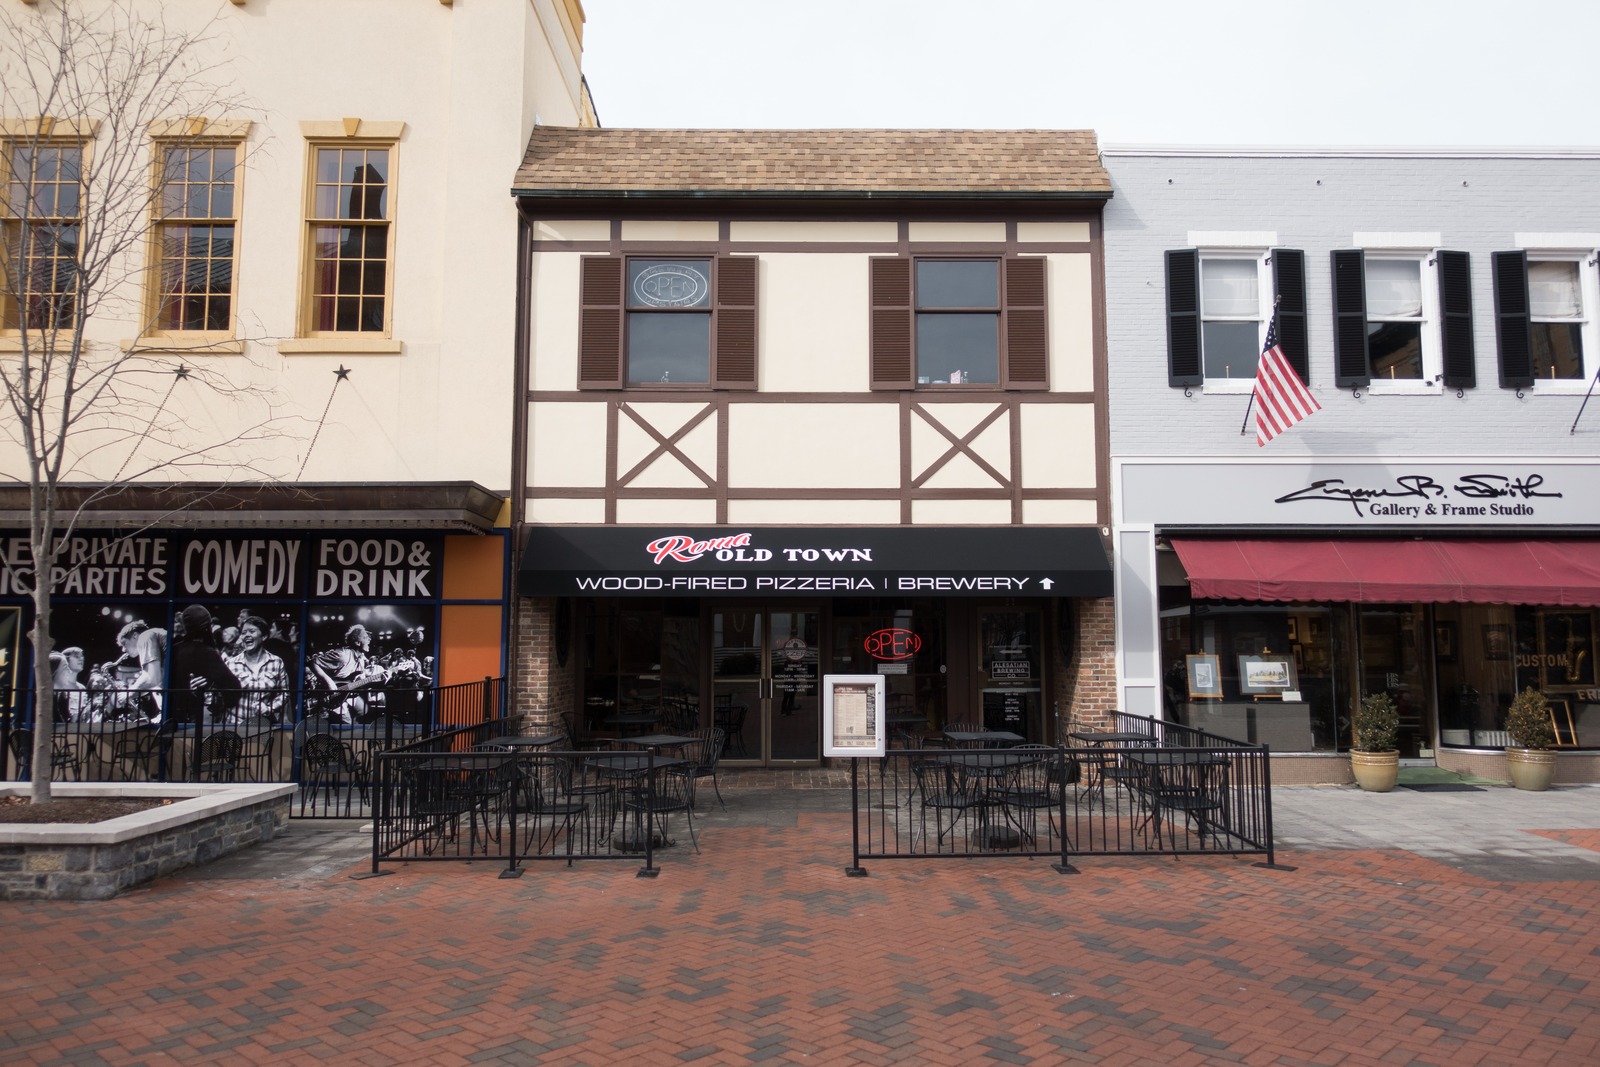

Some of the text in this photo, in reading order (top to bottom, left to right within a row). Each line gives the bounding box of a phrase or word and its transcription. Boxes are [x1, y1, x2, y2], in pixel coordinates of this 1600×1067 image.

[645, 276, 695, 298] OPEN
[1370, 503, 1534, 518] Gallery & Frame Studio
[52, 537, 168, 565] PRIVATE
[646, 532, 752, 565] Roma
[715, 548, 873, 562] OLD TOWN
[183, 539, 301, 594] COMEDY
[50, 567, 167, 595] PARTIES
[316, 569, 431, 597] DRINK
[575, 577, 747, 590] WOOD-FIRED
[756, 577, 875, 590] PIZZERIA
[898, 577, 1030, 590] BREWERY
[866, 631, 918, 655] OPEN
[1515, 654, 1569, 667] CUSTOM
